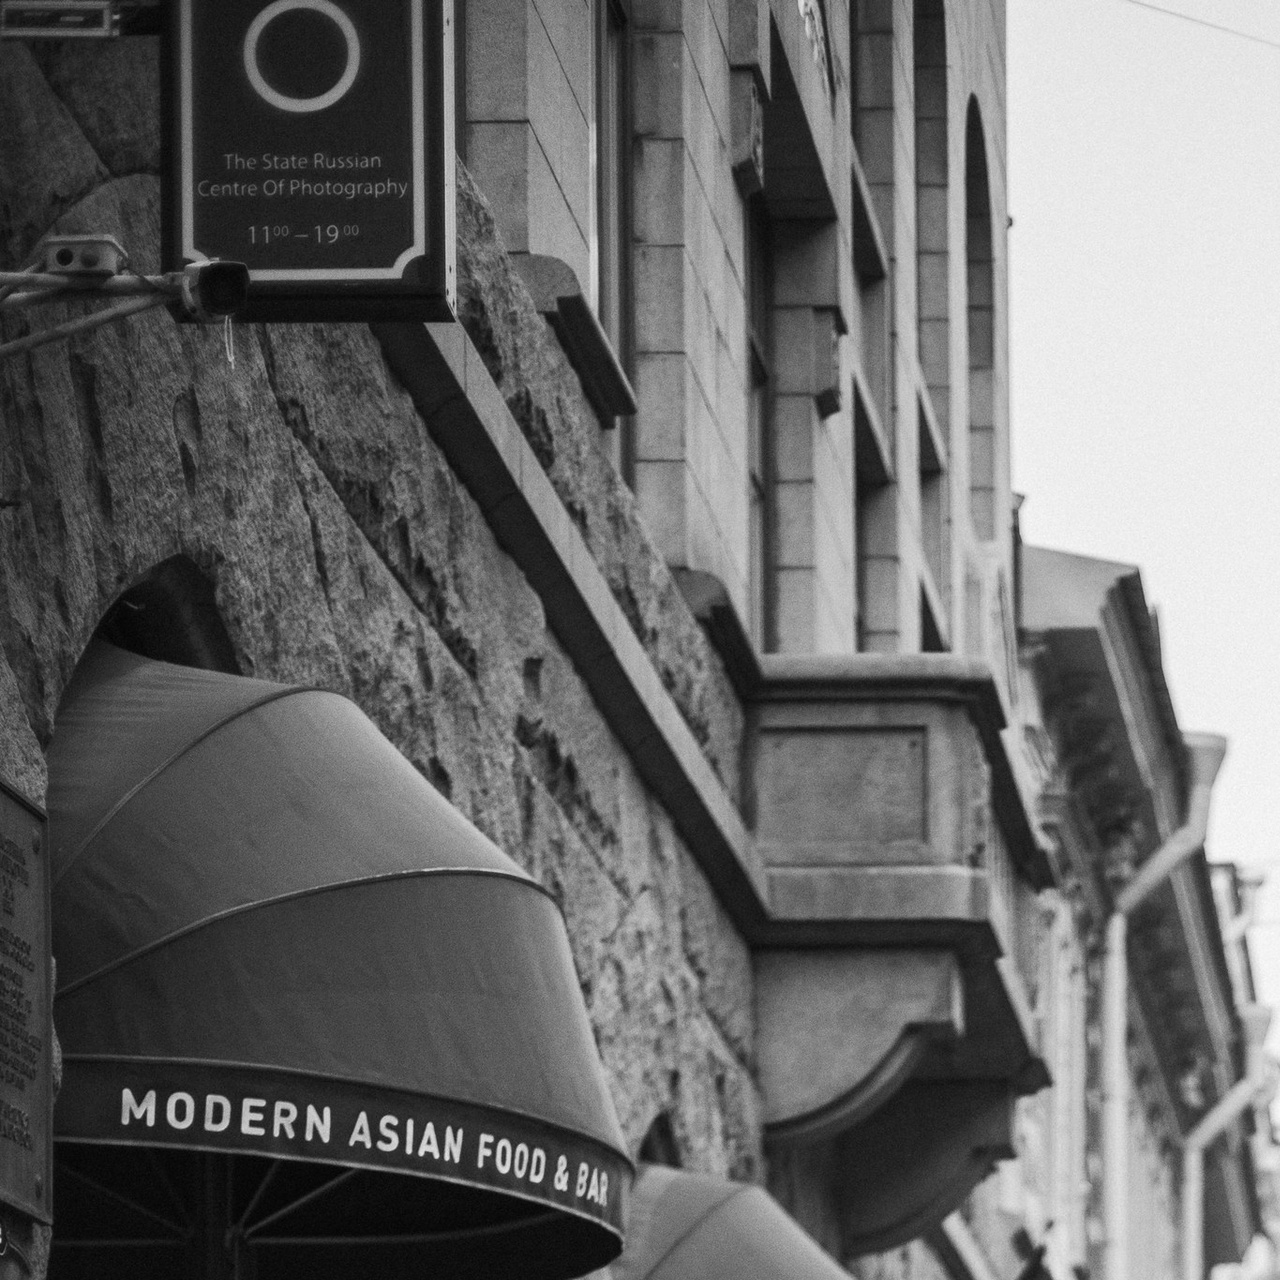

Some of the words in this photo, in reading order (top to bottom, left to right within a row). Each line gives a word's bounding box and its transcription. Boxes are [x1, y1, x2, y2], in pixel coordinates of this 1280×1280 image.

[223, 153, 257, 170] The
[262, 153, 309, 170] State
[313, 152, 382, 169] Russian
[197, 180, 258, 197] Centre
[262, 178, 284, 196] Of
[289, 177, 409, 199] Photography
[120, 1087, 332, 1144] MODERN
[347, 1110, 465, 1164] ASIAN
[476, 1132, 547, 1185] FOOD
[553, 1154, 570, 1193] &
[574, 1161, 609, 1208] BAR
